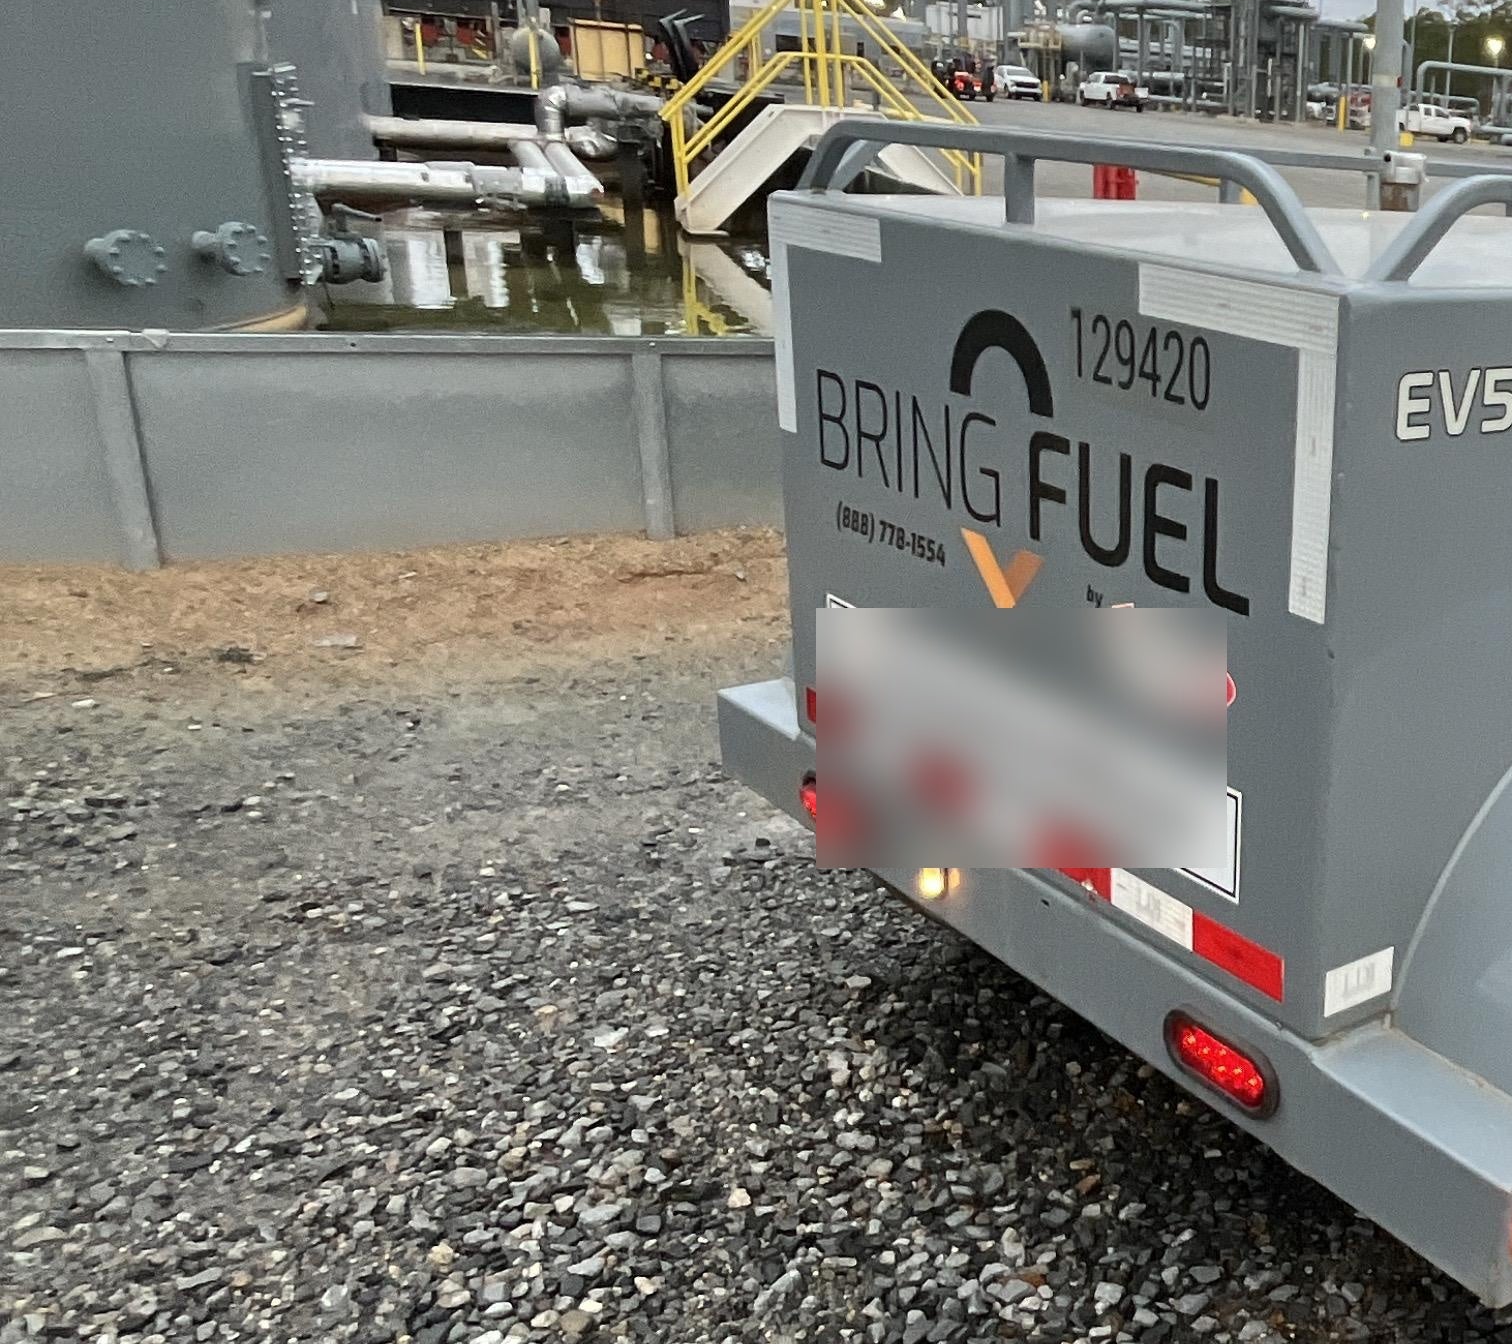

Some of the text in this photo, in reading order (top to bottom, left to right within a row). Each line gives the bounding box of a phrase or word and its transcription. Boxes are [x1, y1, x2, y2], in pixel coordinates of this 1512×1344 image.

[1069, 306, 1211, 410] 129420
[816, 368, 1250, 616] BRING FUEL
[836, 500, 947, 568] (888) 778-1554
[1086, 584, 1105, 608] by
